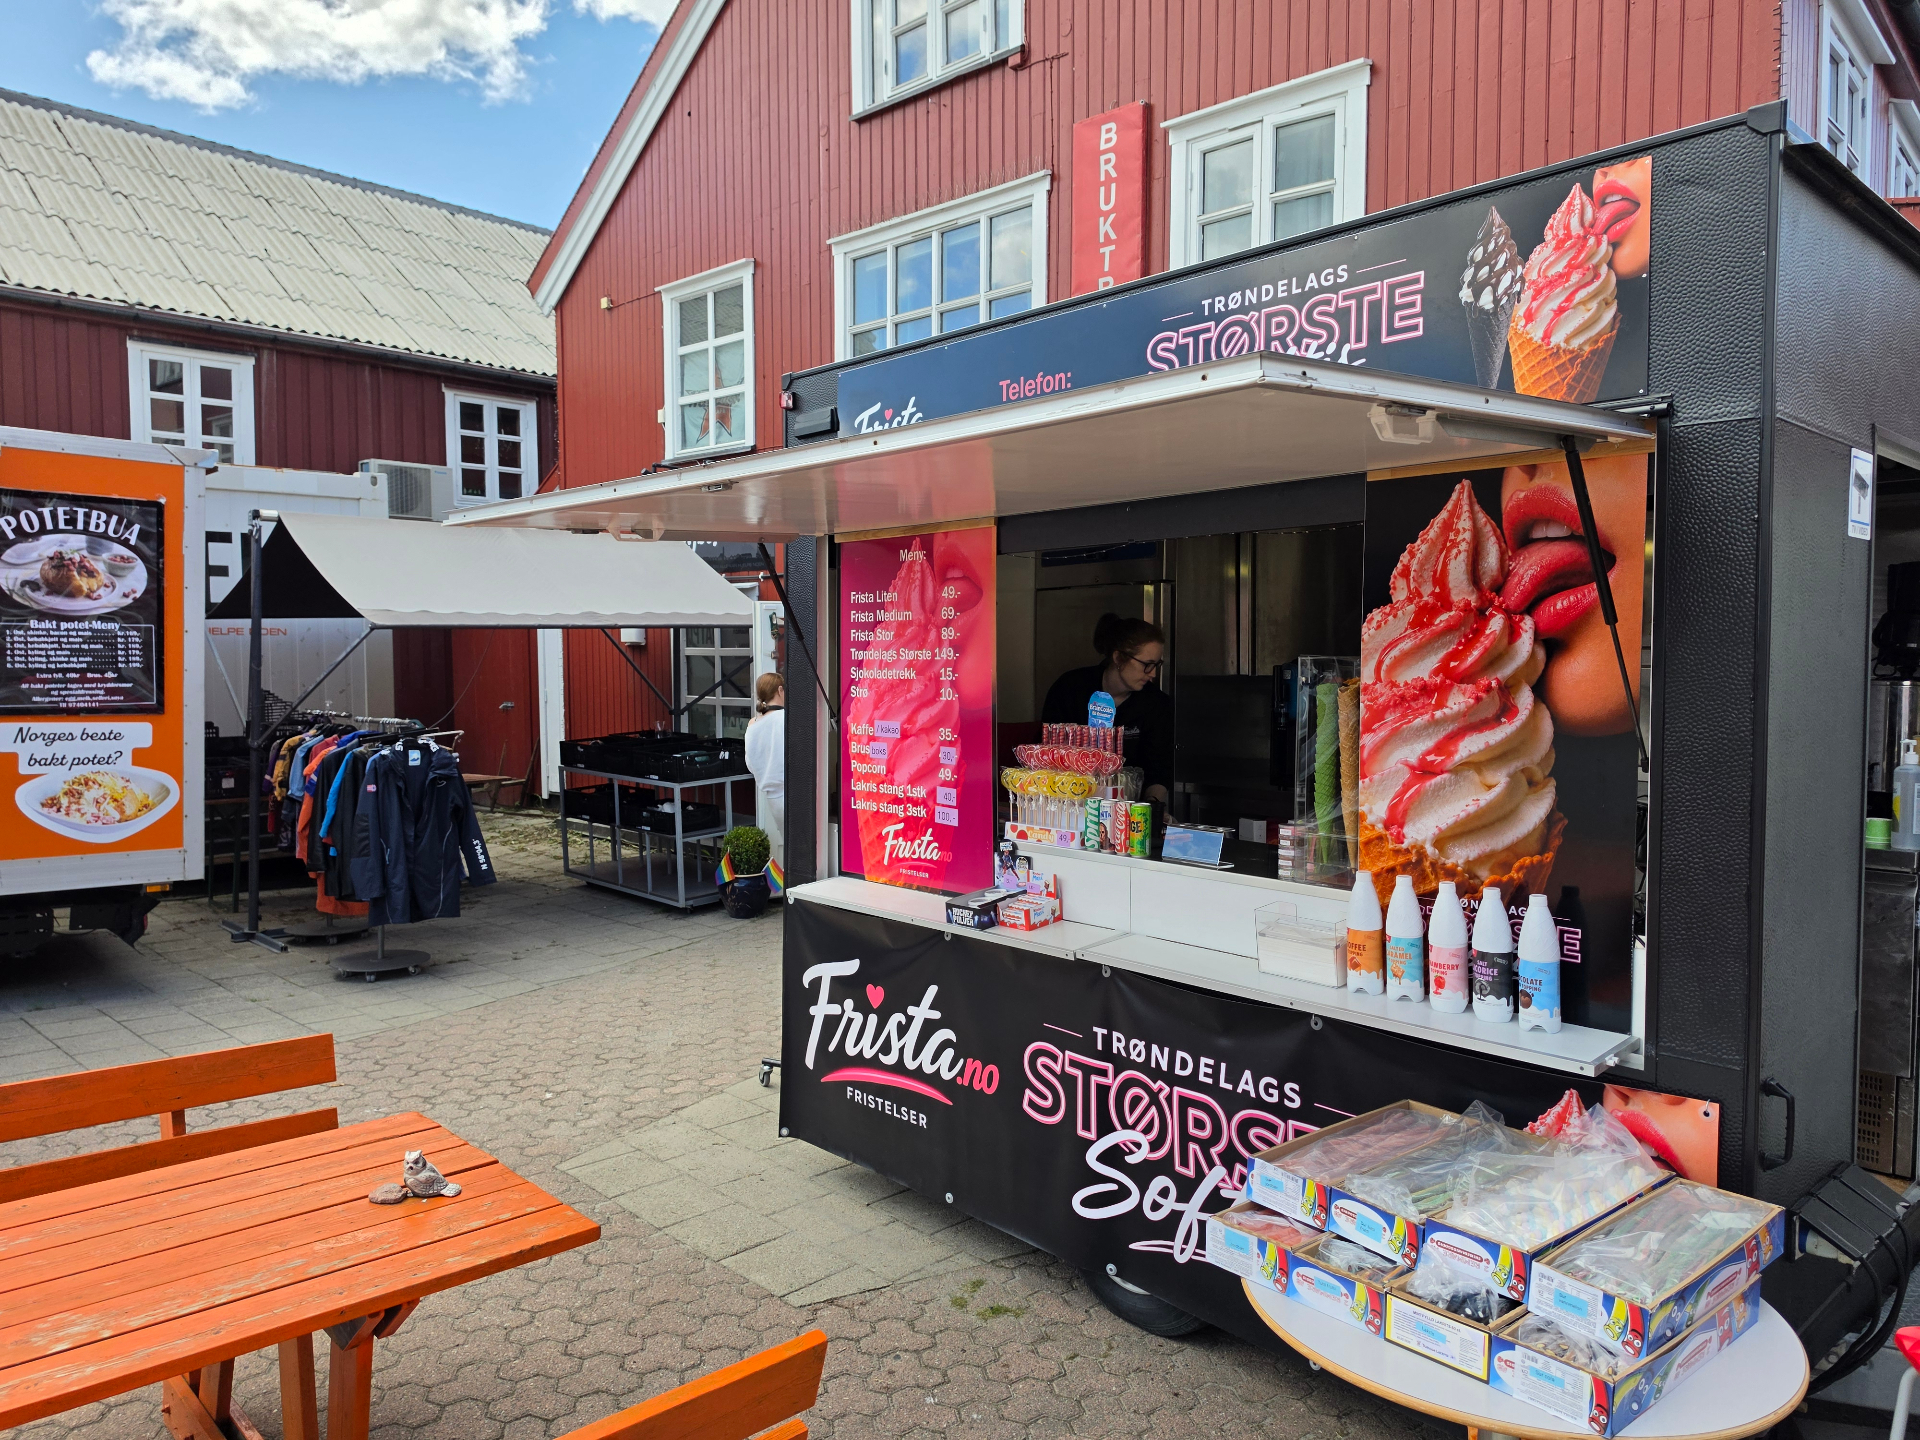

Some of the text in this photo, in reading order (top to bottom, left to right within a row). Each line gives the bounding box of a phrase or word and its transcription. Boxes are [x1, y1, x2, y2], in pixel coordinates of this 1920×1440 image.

[1201, 264, 1349, 316] TRØNDELAGS
[1146, 271, 1426, 376] STØRSTE
[999, 370, 1072, 402] Telefon:
[0, 506, 141, 546] POTETBUA
[899, 548, 927, 563] Meny:
[850, 586, 961, 604] Frista Liten 49.-
[850, 606, 961, 623] Frista Medium 69.-
[30, 620, 121, 632] Bakt potet-Meny
[850, 626, 961, 642] Frista Stor 89.-
[850, 646, 960, 662] Trøndelags Største 149.-
[850, 666, 959, 682] Sjokoladetrekk 15.-
[850, 685, 959, 702] Strø 10.-
[13, 726, 124, 746] Norges beste
[851, 723, 874, 736] Kaffe
[938, 728, 958, 741] 35.-
[851, 742, 870, 754] Brus
[27, 751, 123, 771] bakt potet?
[851, 760, 958, 781] Popcorn 49.-
[851, 779, 877, 792] Lakris
[879, 783, 905, 798] stang
[906, 785, 926, 798] 1stk
[851, 797, 877, 811] Lakris
[879, 801, 905, 817] stang
[906, 804, 927, 818] 3stk
[1100, 810, 1112, 818] NTA
[1084, 798, 1099, 849] Sprite
[1130, 820, 1142, 834] GE
[1028, 829, 1054, 844] Candy
[899, 868, 929, 879] FRISTELSER
[1347, 941, 1366, 952] OFFEE
[1429, 960, 1460, 970] AWBERRY
[1473, 964, 1498, 976] ICORICE
[1519, 975, 1543, 986] COLATE
[1093, 1026, 1301, 1110] TRØNDELAGS
[846, 1085, 928, 1130] FRISTELSER
[1022, 1041, 1320, 1194] STØRS
[1072, 1130, 1246, 1264] Sof
